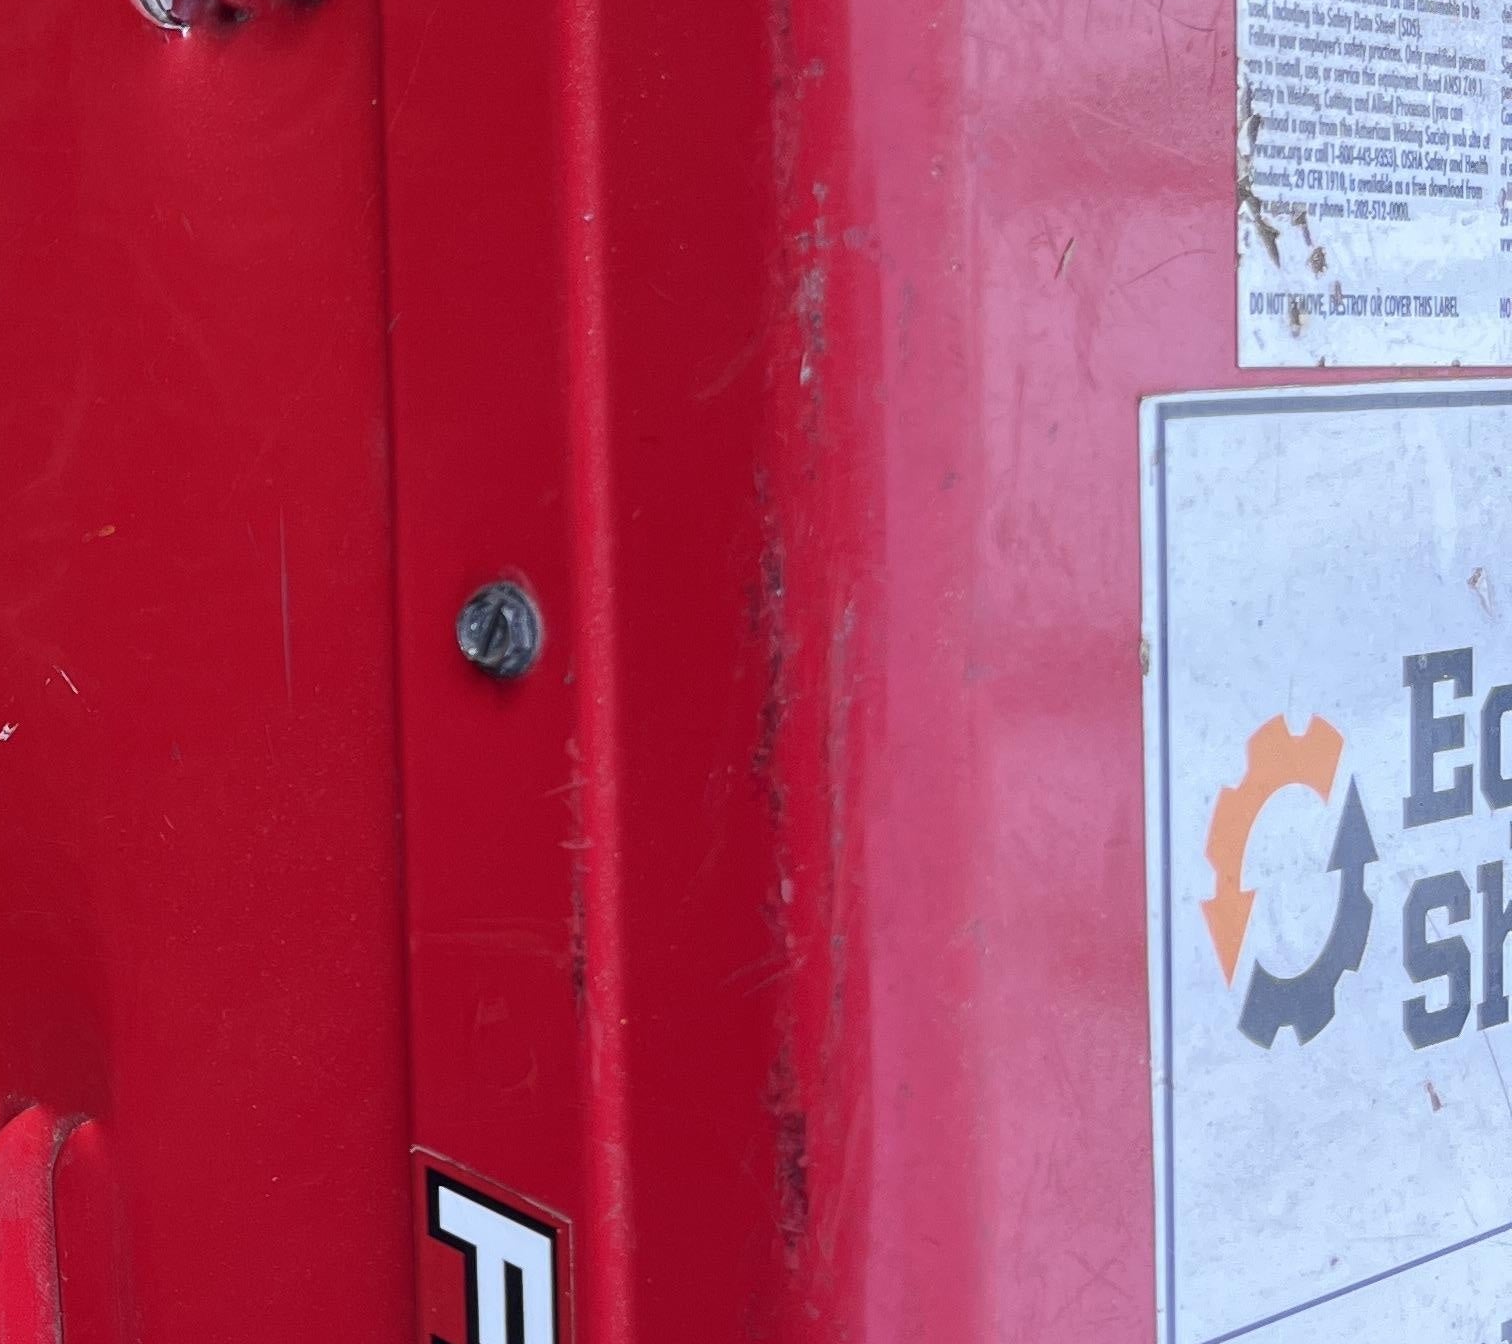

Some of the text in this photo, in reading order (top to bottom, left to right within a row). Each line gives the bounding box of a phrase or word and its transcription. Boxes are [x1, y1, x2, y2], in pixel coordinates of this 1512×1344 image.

[1249, 291, 1263, 314] DO
[1265, 292, 1286, 314] NOT
[1369, 295, 1383, 316] OR
[1384, 295, 1411, 316] COVER
[1412, 296, 1432, 317] THIS
